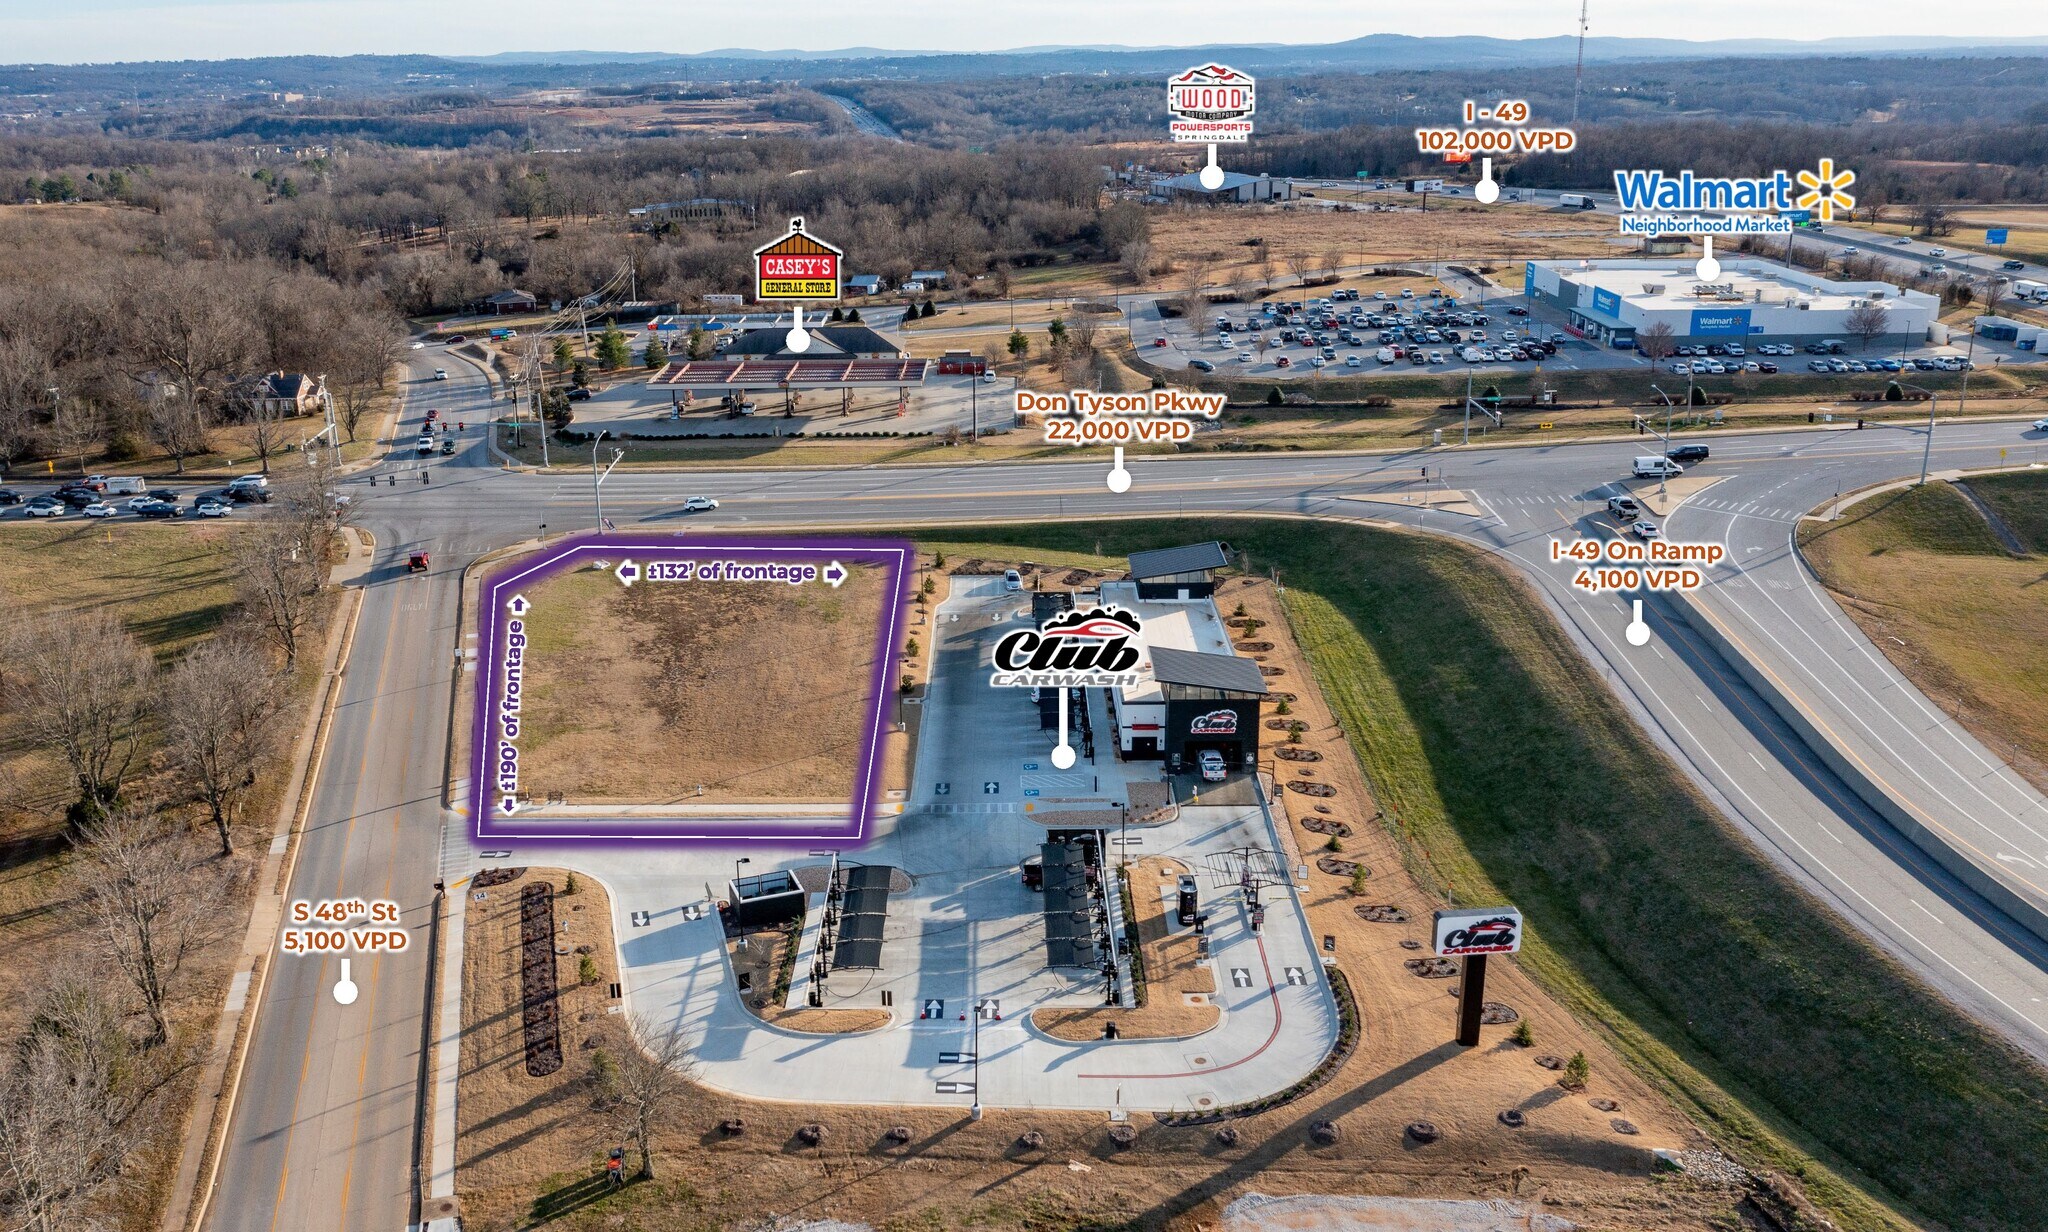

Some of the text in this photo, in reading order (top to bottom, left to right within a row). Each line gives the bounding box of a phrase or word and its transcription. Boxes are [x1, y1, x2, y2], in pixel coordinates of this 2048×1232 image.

[1700, 316, 1733, 325] Walmart
[1192, 716, 1237, 729] Club
[1444, 928, 1515, 948] Club
[1442, 945, 1513, 955] CARWASH
